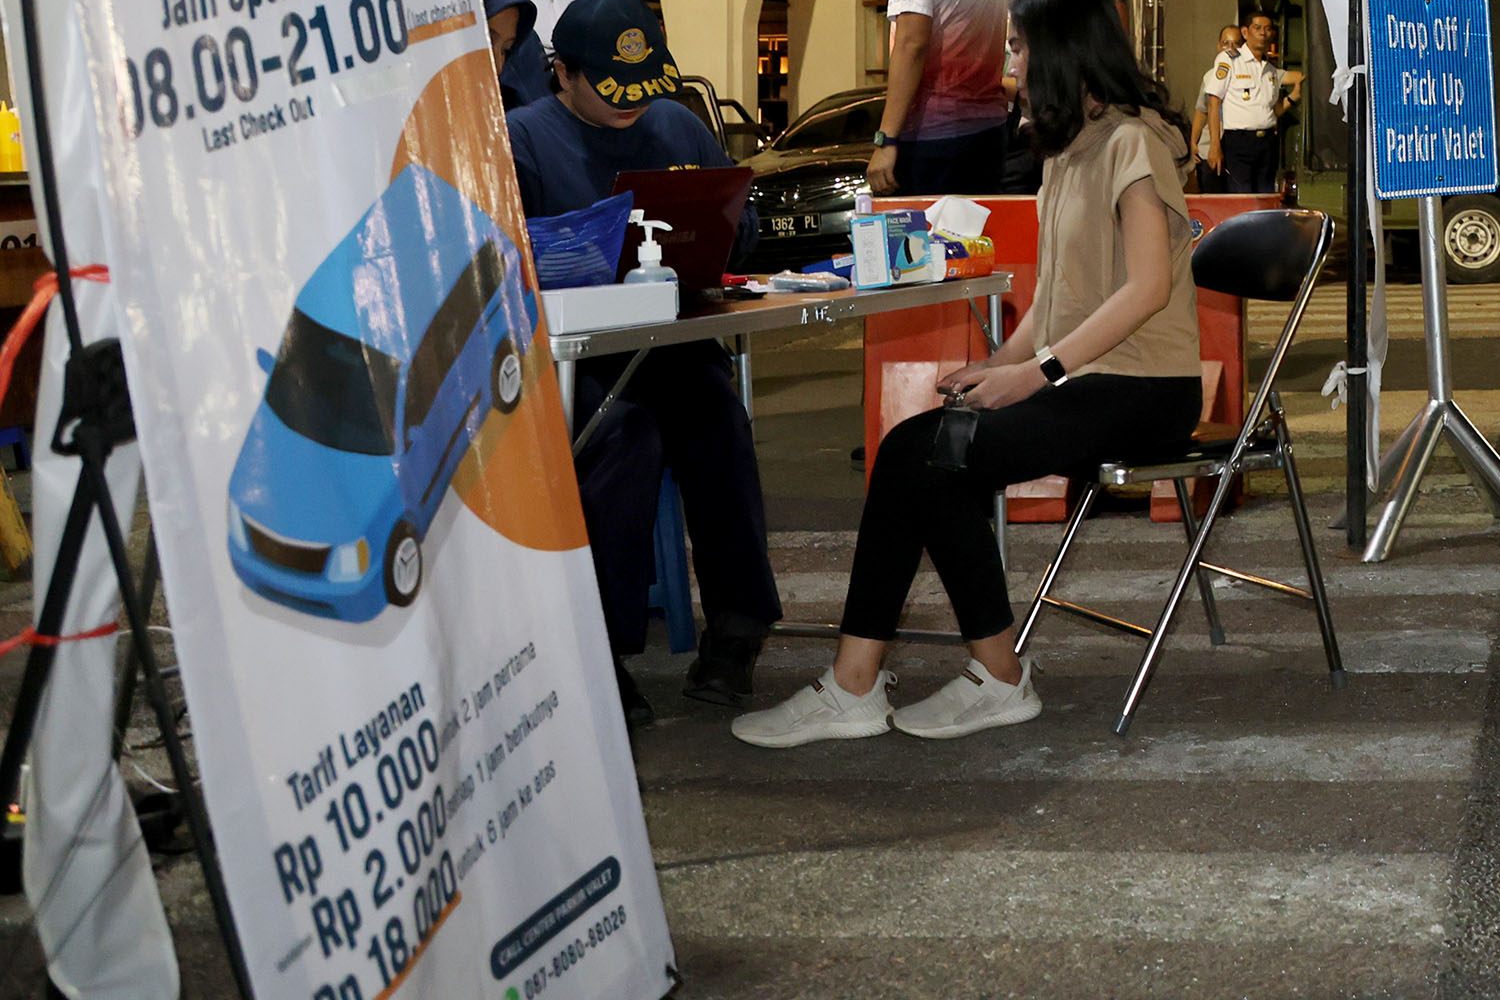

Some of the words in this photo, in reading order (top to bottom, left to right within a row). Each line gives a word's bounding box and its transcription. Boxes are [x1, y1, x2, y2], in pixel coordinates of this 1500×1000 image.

[1386, 13, 1429, 59] Drop
[1433, 15, 1459, 52] Off
[596, 63, 680, 104] DISHUB
[1402, 68, 1437, 106] Pick
[1442, 72, 1465, 115] Up
[201, 121, 237, 153] Last
[239, 103, 287, 140] Check
[289, 96, 315, 123] Out
[1386, 124, 1438, 164] Parkir
[1442, 124, 1486, 161] Valet
[771, 216, 795, 231] 1362
[804, 215, 818, 230] PL
[287, 744, 339, 812] Tarif
[339, 681, 426, 769] Layanan
[273, 835, 323, 905] Rp
[325, 718, 440, 852] 10.000
[461, 697, 472, 723] 2
[311, 888, 363, 959] Rp
[364, 784, 447, 910] 2.000
[367, 850, 458, 989] 18.000
